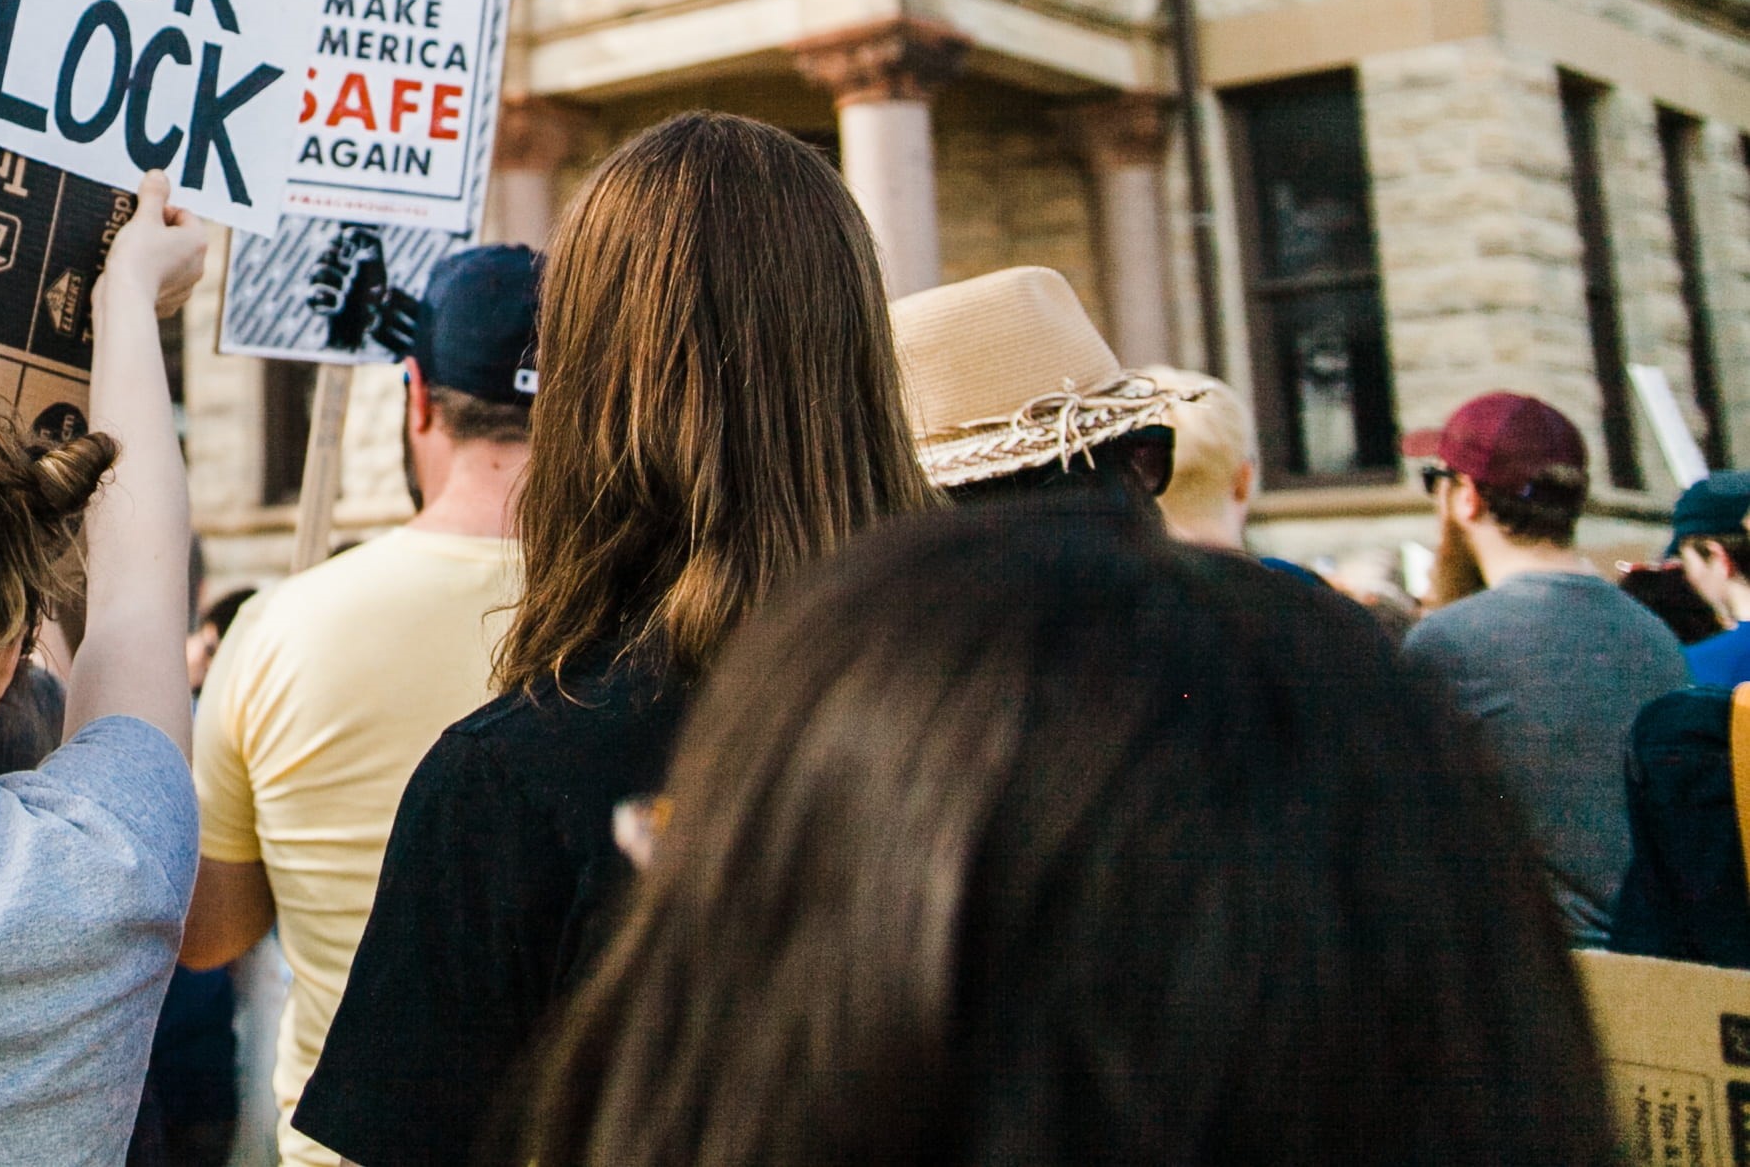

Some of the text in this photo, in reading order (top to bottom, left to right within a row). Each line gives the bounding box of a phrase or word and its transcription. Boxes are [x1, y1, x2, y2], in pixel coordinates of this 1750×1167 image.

[317, 26, 468, 72] MERICA
[298, 136, 432, 177] AGAIN
[101, 186, 133, 245] Displ
